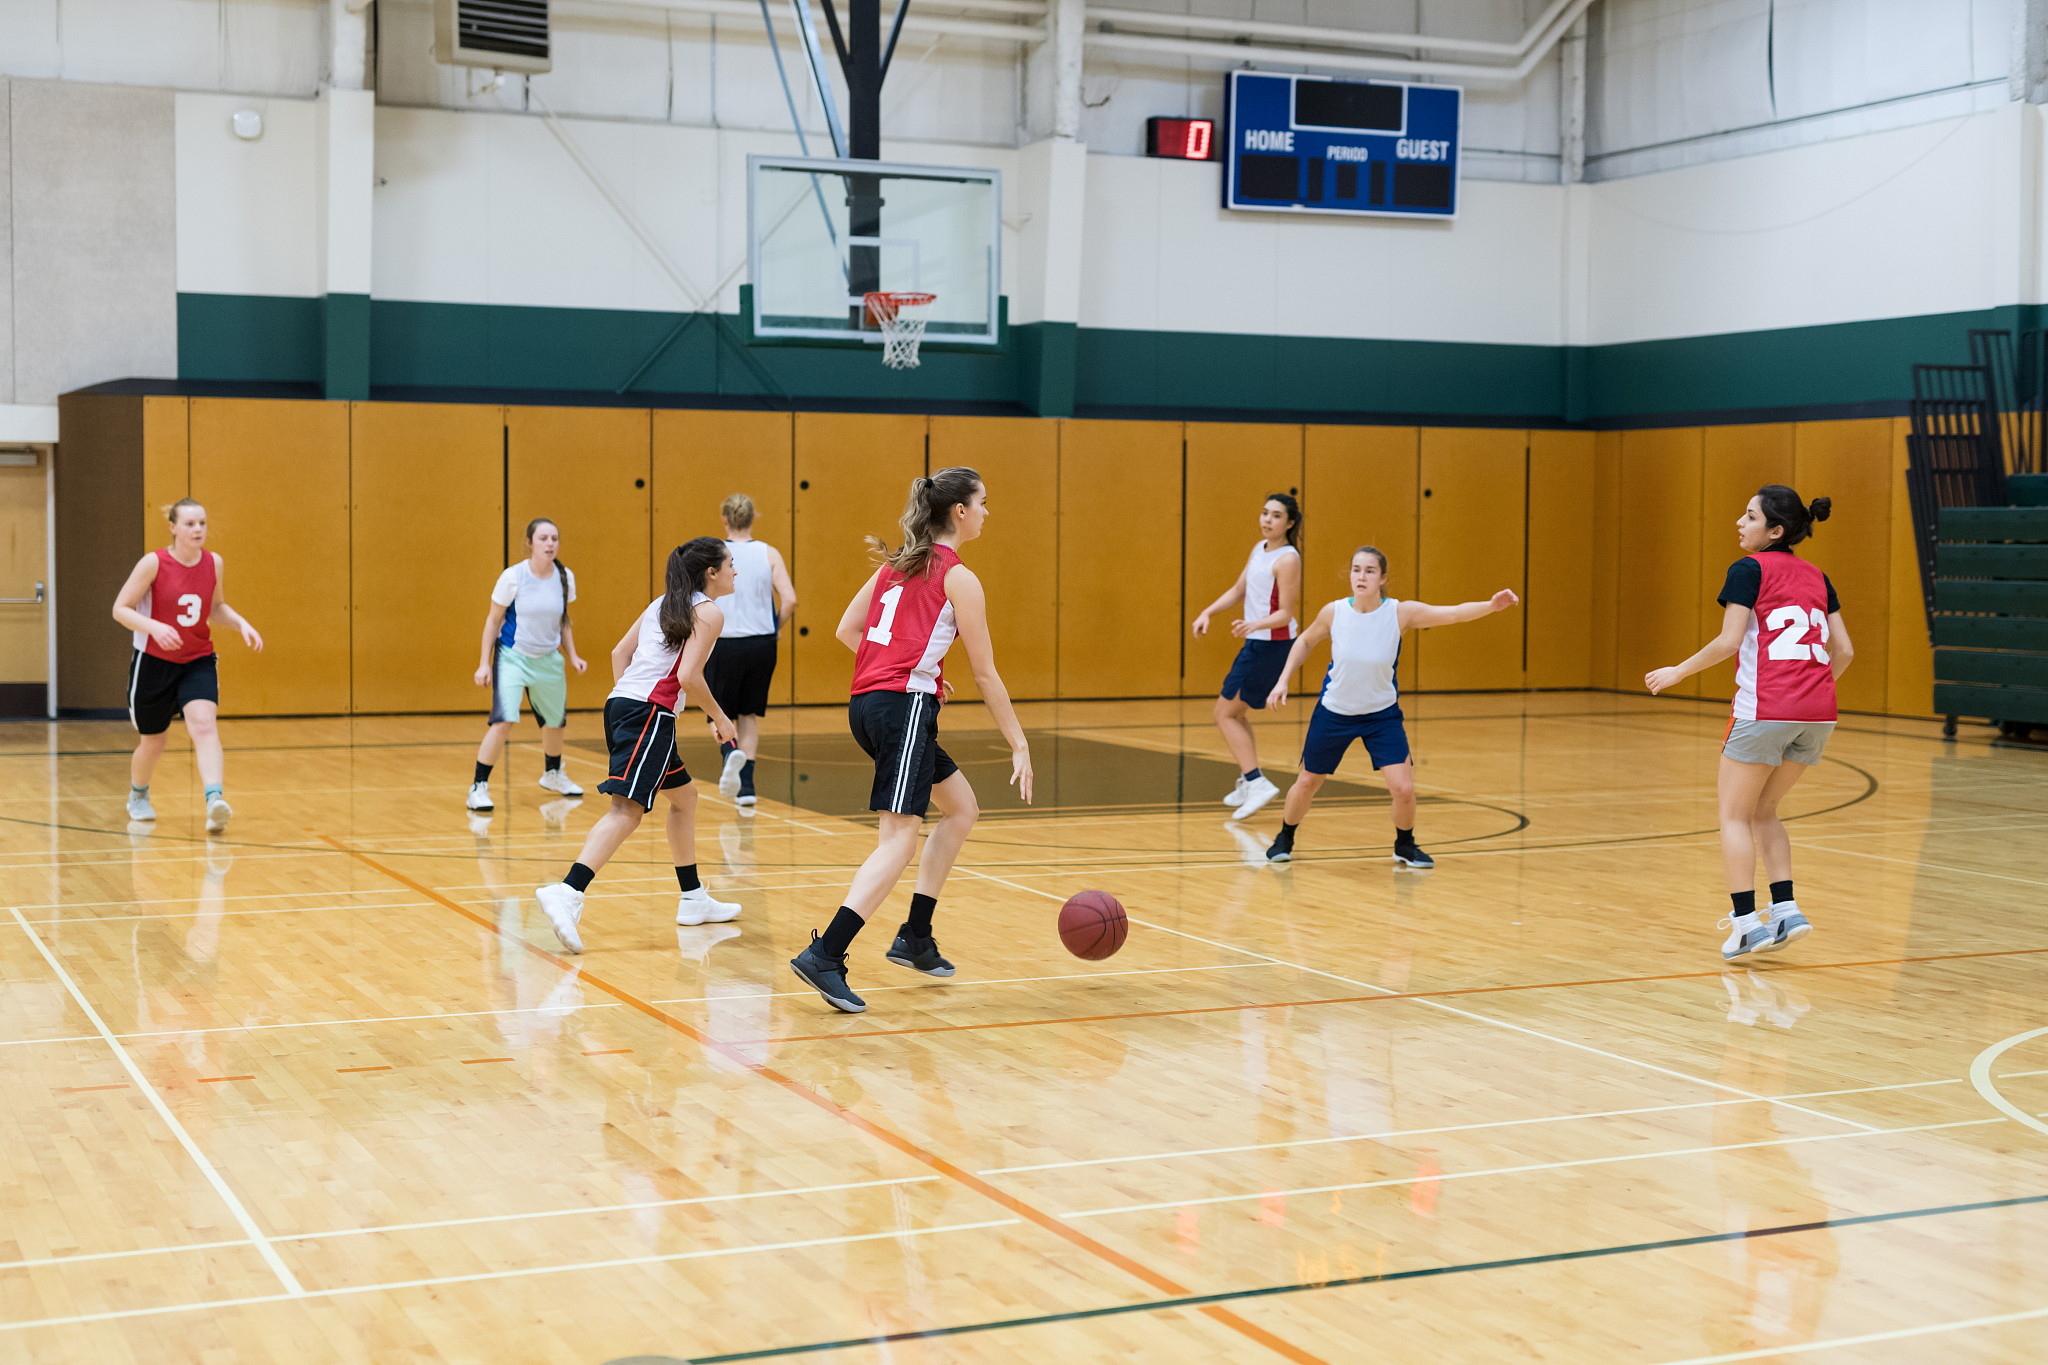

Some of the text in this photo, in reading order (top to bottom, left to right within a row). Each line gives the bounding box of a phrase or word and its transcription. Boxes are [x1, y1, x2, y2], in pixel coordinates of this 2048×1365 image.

[1186, 120, 1212, 159] 0
[1245, 129, 1294, 152] HOME
[1327, 145, 1368, 162] PERIOD
[1396, 138, 1450, 161] GUEST
[177, 593, 202, 627] 3
[866, 585, 904, 646] 1
[1766, 605, 1830, 666] 23
